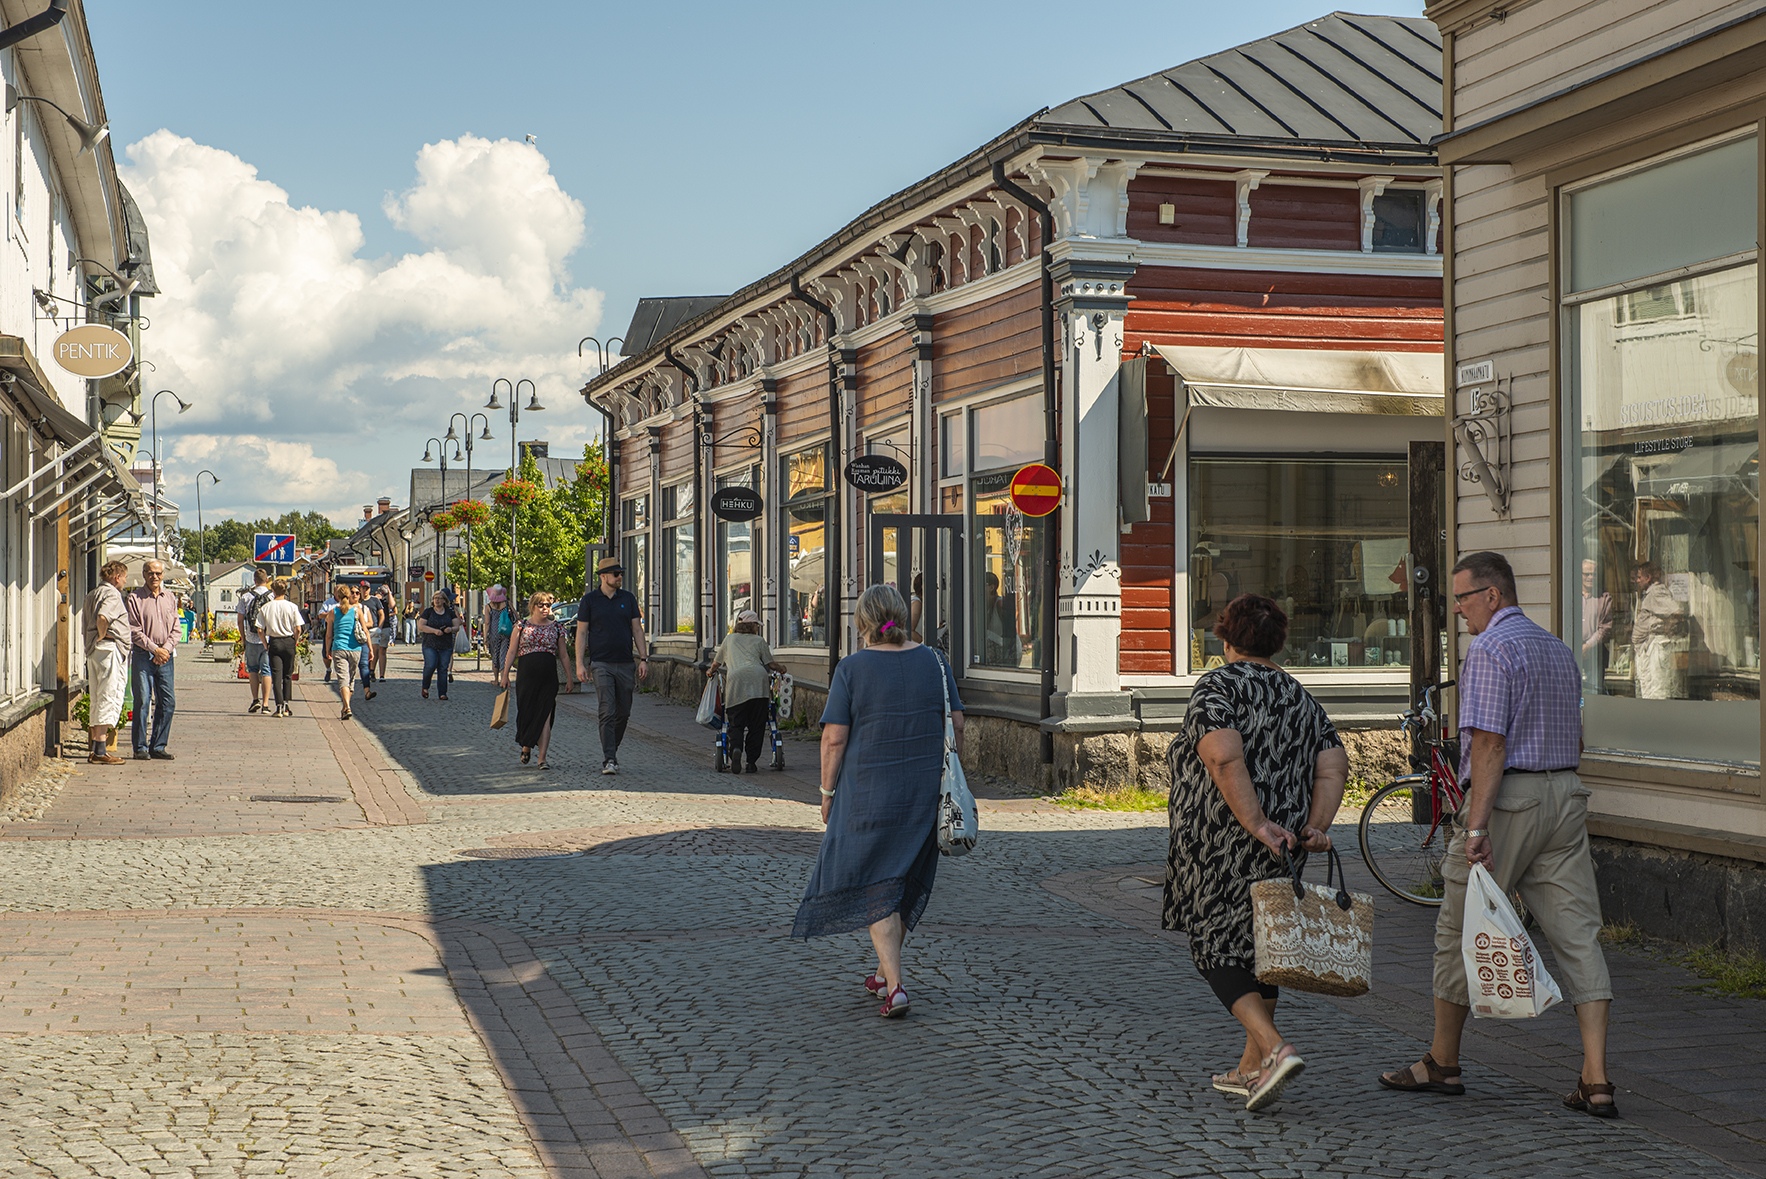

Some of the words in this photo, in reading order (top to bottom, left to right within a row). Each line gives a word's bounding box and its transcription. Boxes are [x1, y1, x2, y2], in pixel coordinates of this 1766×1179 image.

[60, 342, 120, 359] PENTIK
[1620, 398, 1677, 425] SISUSTUS
[1679, 393, 1708, 417] IDEA
[1634, 438, 1670, 454] LIFESTYLE
[1670, 436, 1694, 450] STORE
[851, 472, 902, 486] TARULIINA
[722, 500, 753, 510] HEHKU
